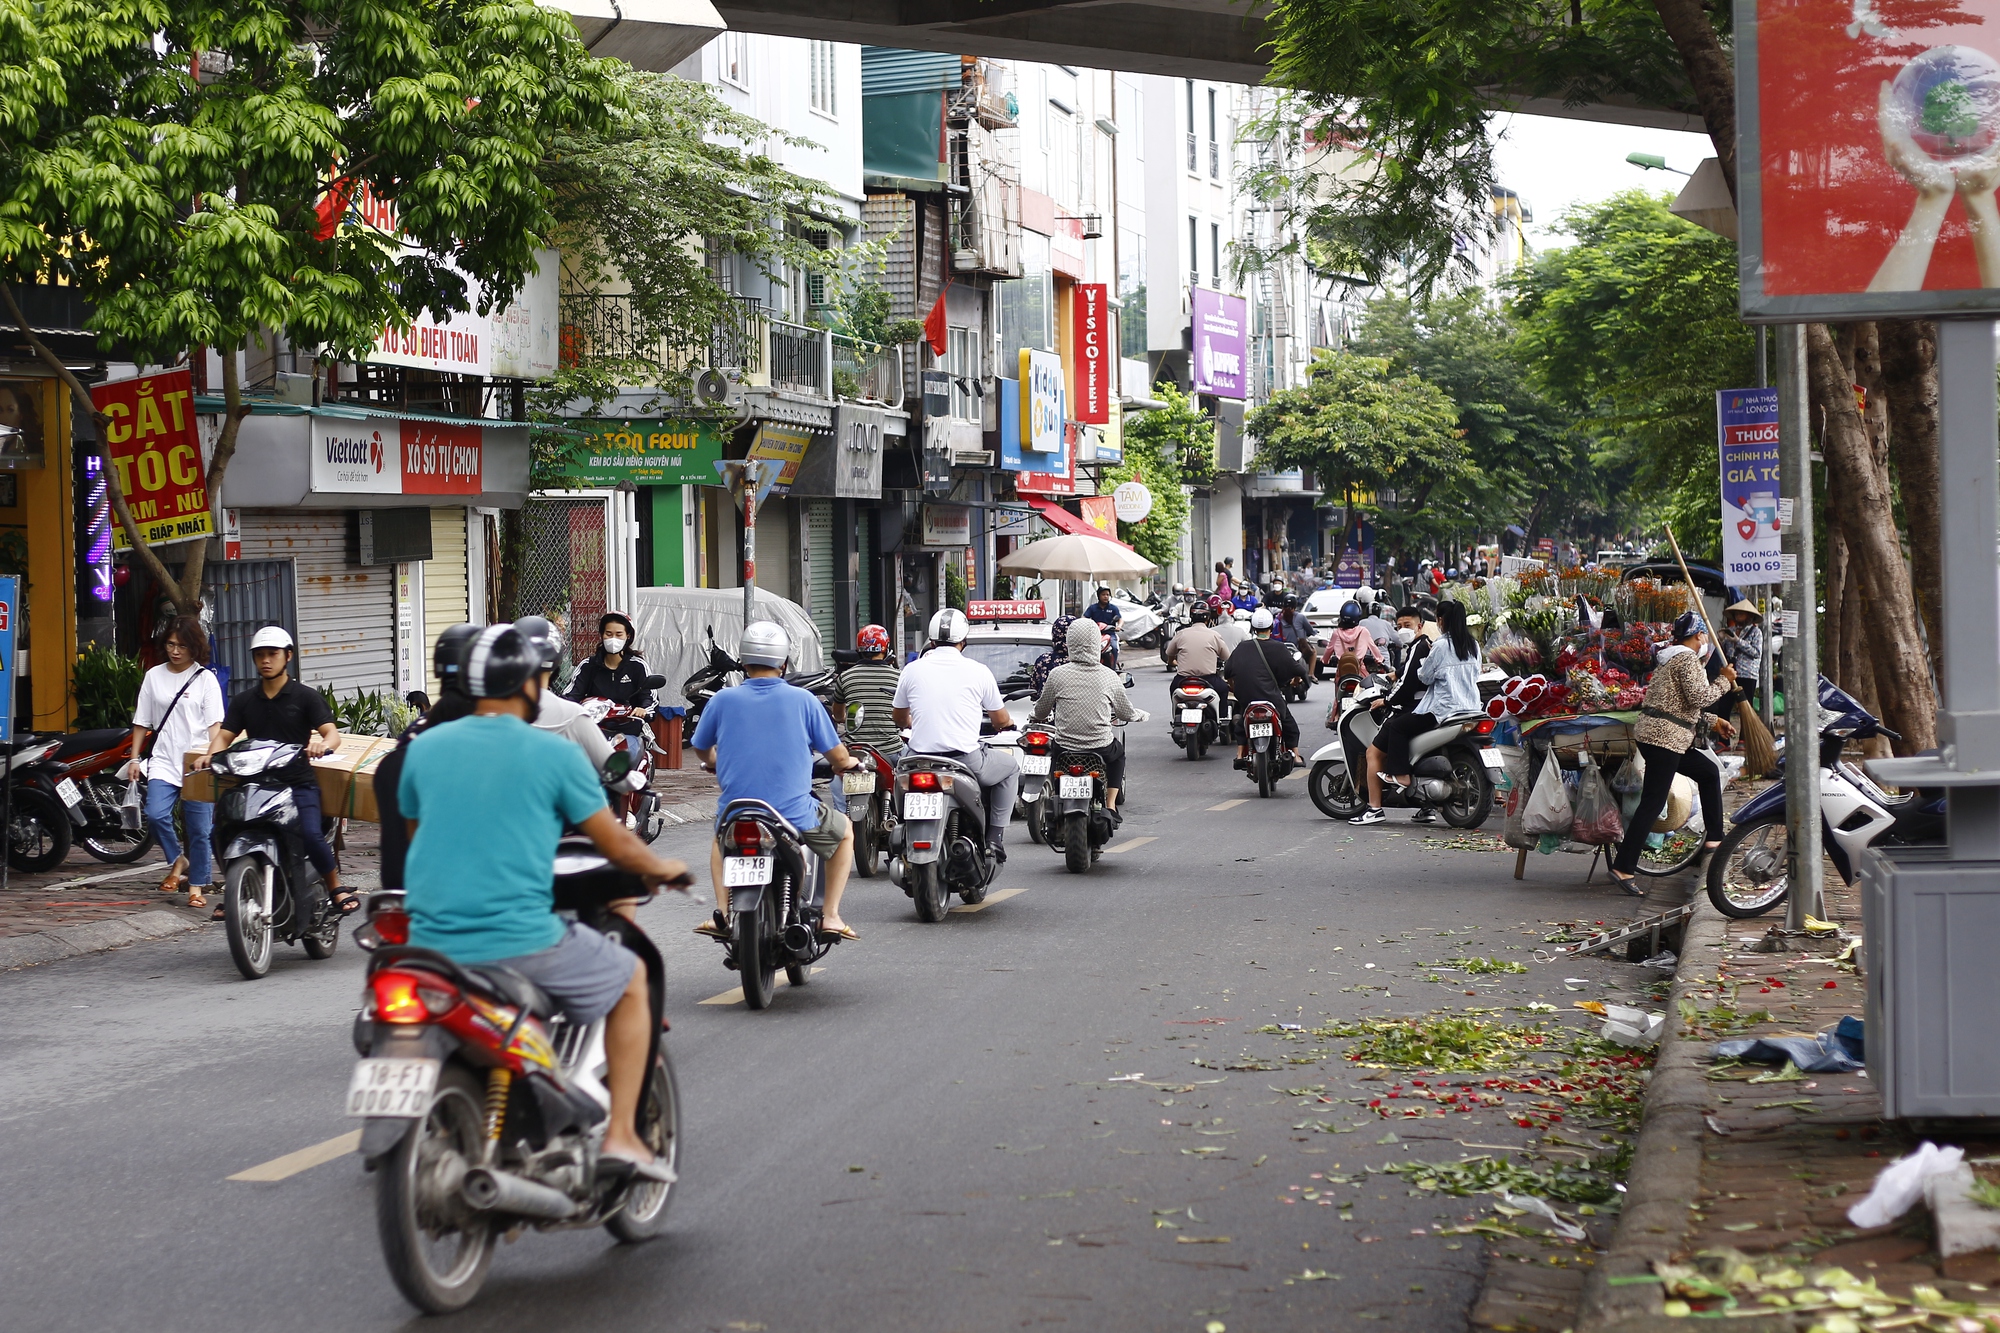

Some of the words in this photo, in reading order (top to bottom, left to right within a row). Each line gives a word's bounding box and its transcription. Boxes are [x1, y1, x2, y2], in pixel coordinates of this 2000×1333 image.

[421, 324, 447, 366] ĐIỆN
[451, 328, 478, 364] TOÁN
[1745, 395, 1759, 404] NHÀ
[1761, 392, 1778, 404] THUỐ
[101, 380, 188, 443] CẮT
[1745, 405, 1768, 414] LONG
[1769, 403, 1778, 413] C
[649, 433, 699, 449] FRUIT
[326, 436, 368, 465] Vietlott
[407, 429, 421, 474] XỔ
[423, 434, 437, 475] SỐ
[438, 440, 452, 482] TỰ
[453, 445, 479, 483] CHỌN
[1725, 449, 1760, 462] CHÍNH
[1763, 447, 1779, 461] HÃ
[589, 456, 602, 467] KEM
[602, 455, 612, 467] BƠ
[612, 452, 625, 467] SẦU
[644, 454, 670, 467] NGUYÊN
[670, 453, 682, 467] MÚI
[112, 441, 198, 497] TÓC
[1727, 466, 1757, 483] GIÁ
[177, 487, 205, 514] NỮ
[149, 522, 175, 541] GIÁP
[177, 514, 206, 536] NHẤT
[1741, 551, 1757, 559] GỌI
[1730, 562, 1761, 573] 1800
[1764, 560, 1780, 571] 69
[970, 603, 1041, 616] 35.333.666
[1064, 777, 1088, 787] 29-AA
[1062, 787, 1091, 797] 025.86
[909, 794, 938, 806] 29-T6
[909, 806, 937, 817] 2173
[731, 857, 766, 871] 29-X8
[730, 871, 765, 884] 3106
[369, 1065, 424, 1086] 18-F1
[351, 1089, 425, 1112] 000.70
